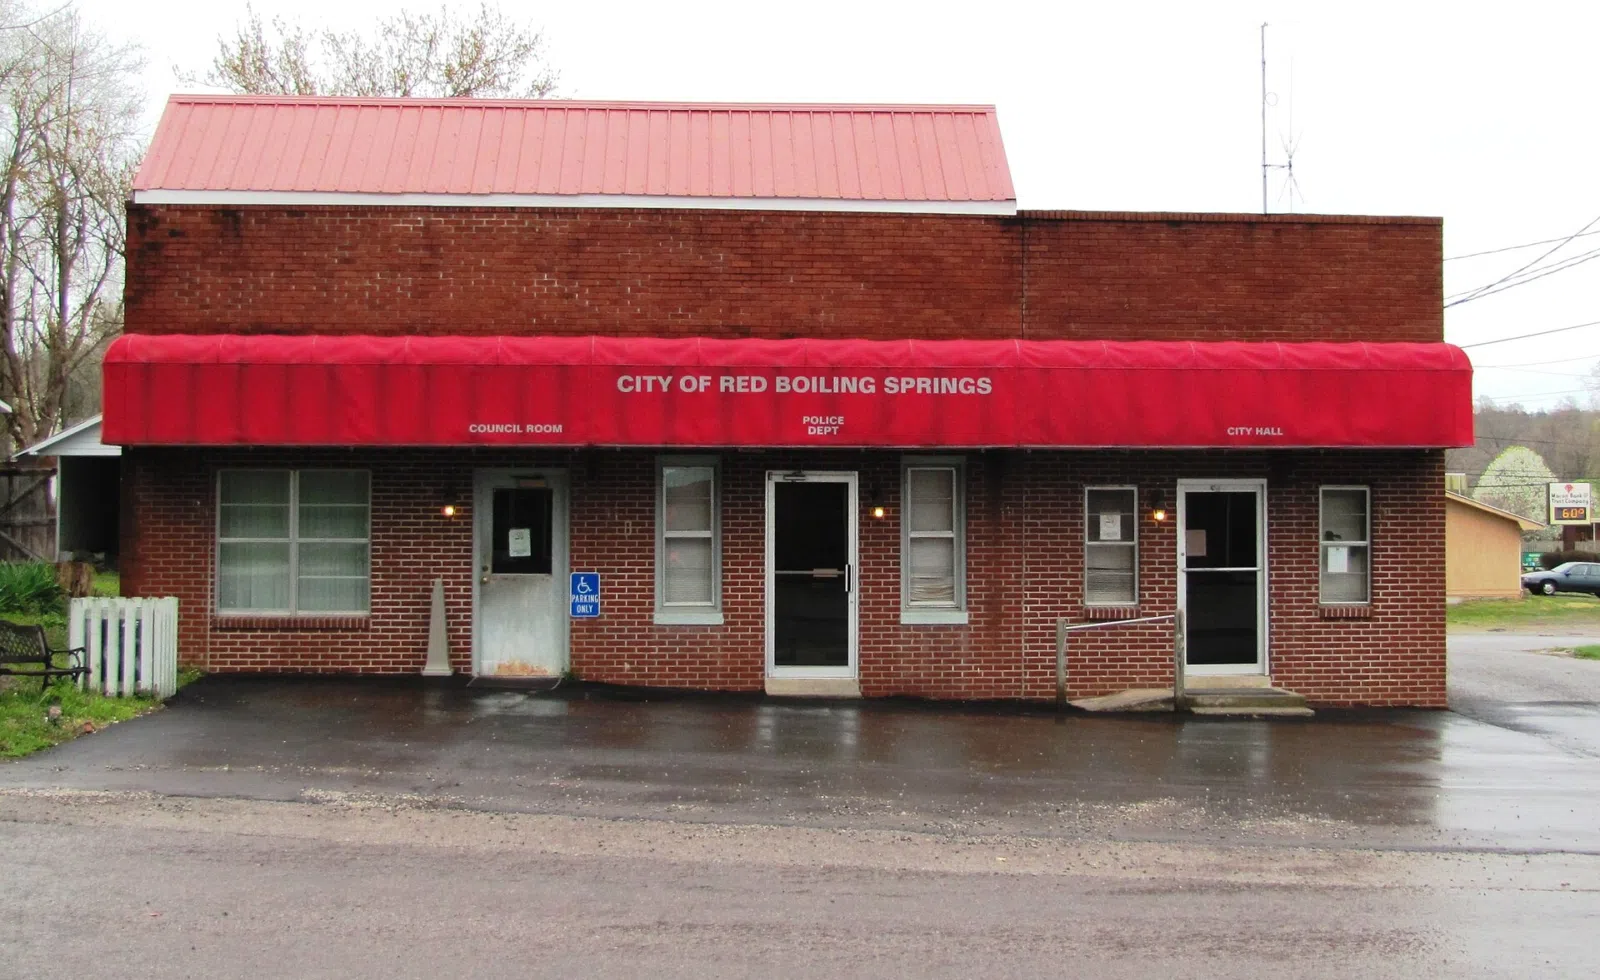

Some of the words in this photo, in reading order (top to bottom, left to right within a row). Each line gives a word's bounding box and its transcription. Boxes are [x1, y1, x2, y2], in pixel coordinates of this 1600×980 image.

[617, 375, 673, 393] CITY
[679, 375, 712, 393] OF
[719, 375, 768, 393] RED
[775, 375, 876, 394] BOILING
[883, 376, 993, 395] SPRINGS
[802, 415, 845, 425] POLICE
[469, 423, 523, 433] COUNCIL
[526, 424, 563, 433] ROOM
[807, 426, 839, 436] DEPT
[1227, 426, 1253, 436] CITY
[1255, 427, 1283, 436] HALL
[572, 594, 598, 603] PARKING
[576, 604, 593, 613] ONLY
